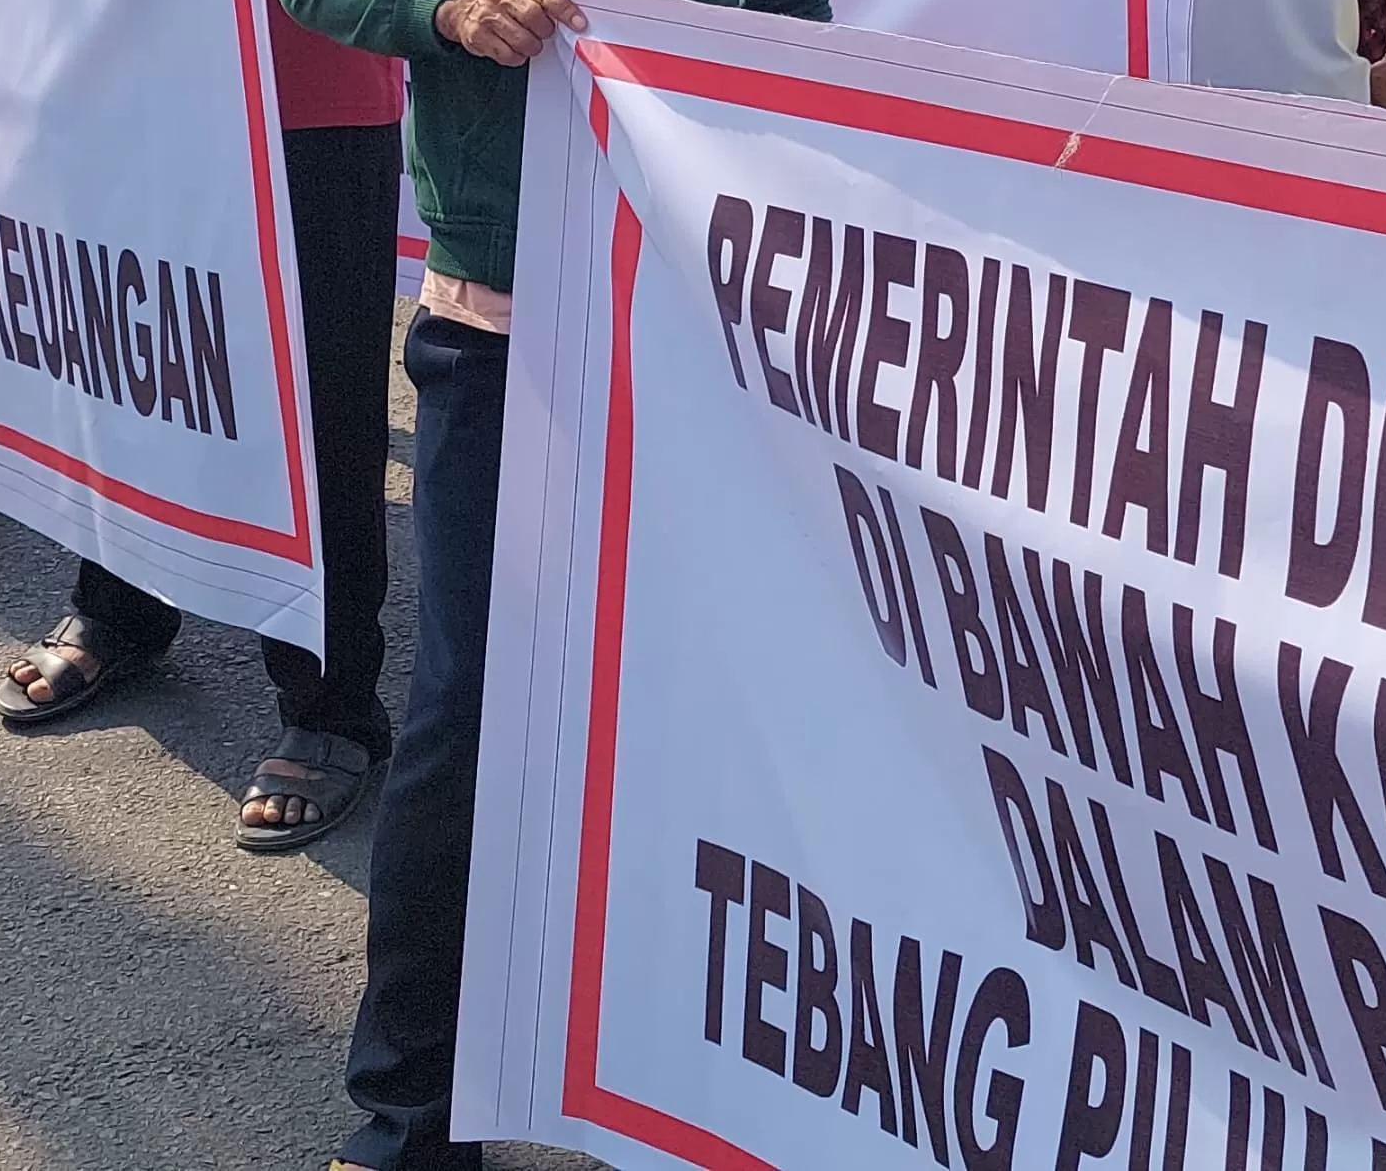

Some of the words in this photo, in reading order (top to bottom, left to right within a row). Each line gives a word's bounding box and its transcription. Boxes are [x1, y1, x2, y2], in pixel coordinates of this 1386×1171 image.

[706, 193, 1268, 581] PEMERINTAH
[833, 462, 937, 690] DI
[919, 505, 1279, 855] BAWAH
[695, 838, 1031, 1171] TEBANG
[981, 743, 1337, 1090] DALAM
